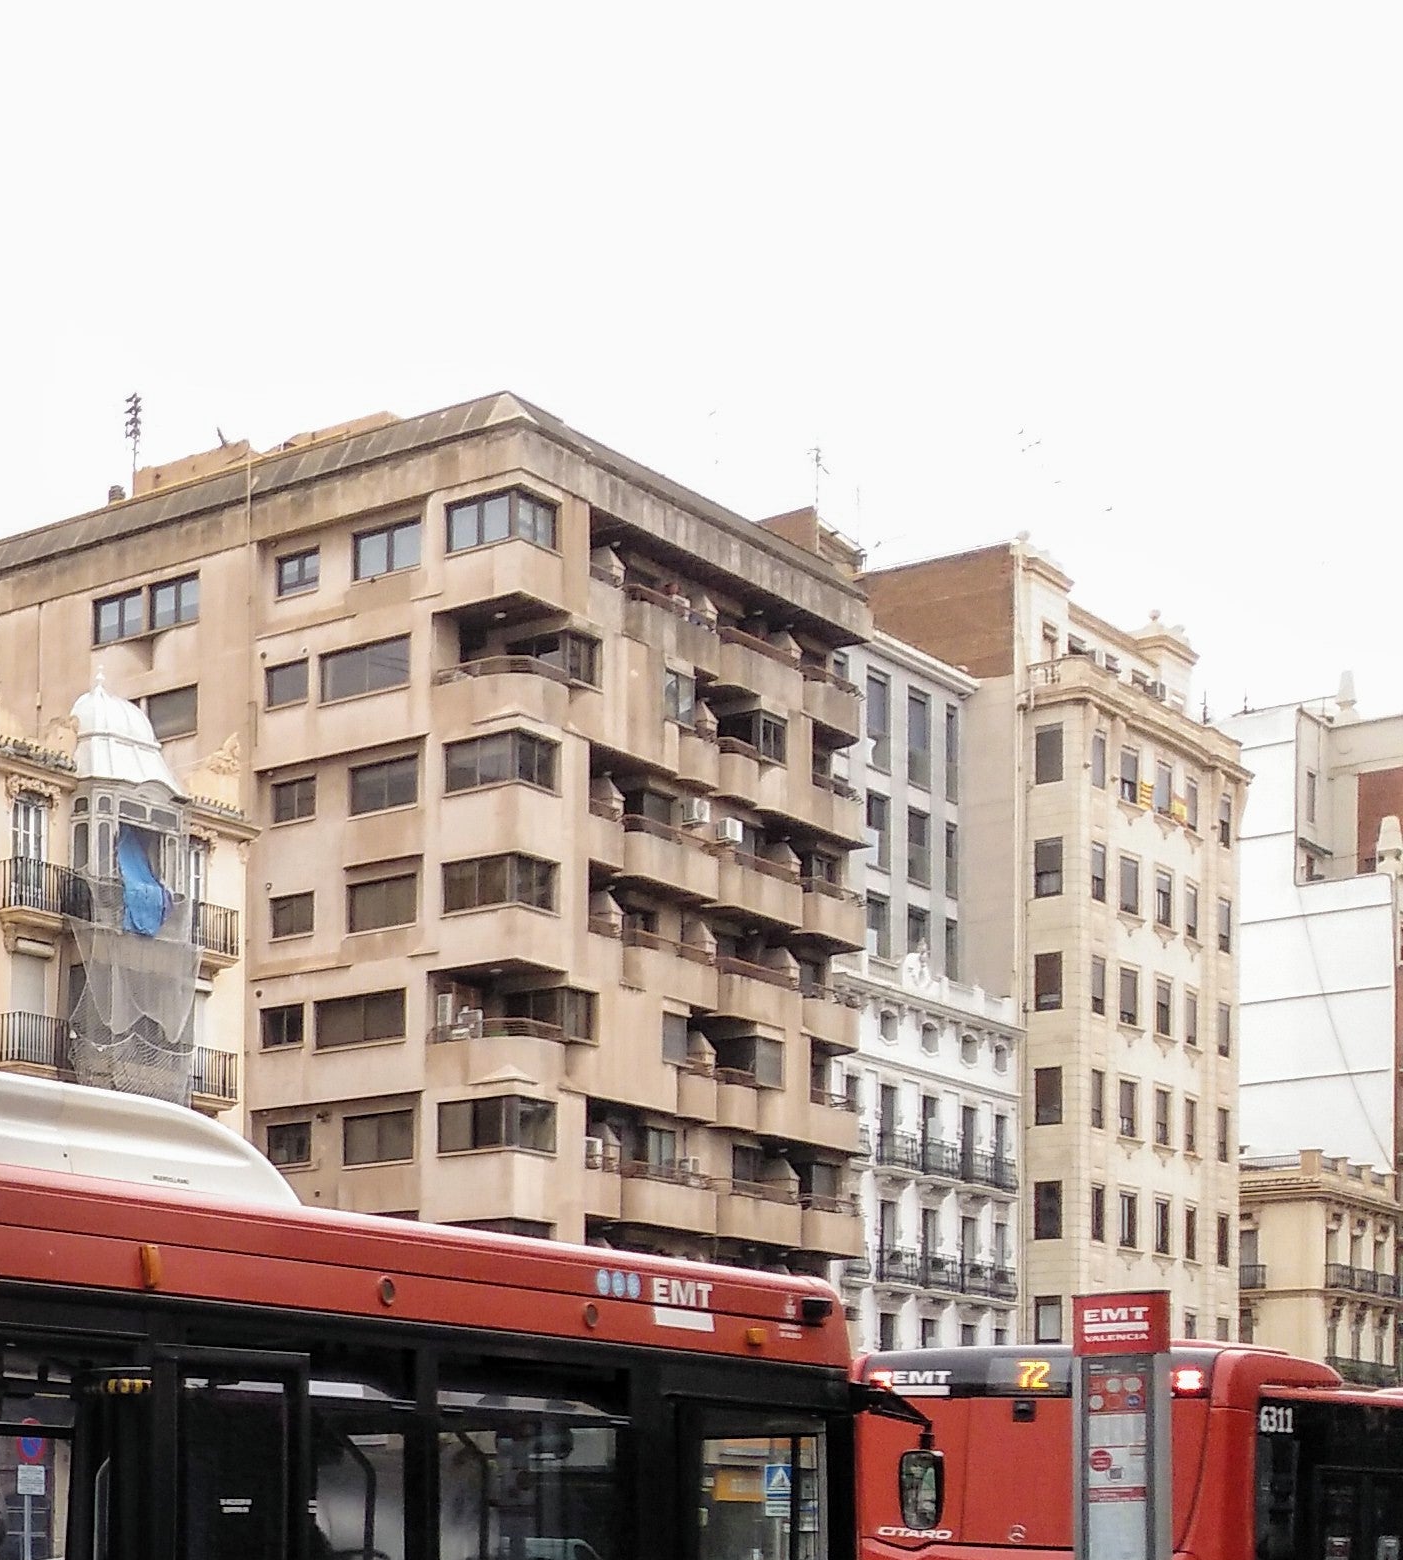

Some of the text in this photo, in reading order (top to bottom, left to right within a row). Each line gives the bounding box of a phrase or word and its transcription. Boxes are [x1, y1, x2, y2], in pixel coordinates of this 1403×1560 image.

[652, 1276, 714, 1309] EMT
[1083, 1306, 1150, 1323] EMT
[1083, 1333, 1149, 1343] VALENCIA
[892, 1370, 953, 1385] EMT
[1016, 1360, 1051, 1389] 72
[1259, 1405, 1294, 1434] 6311
[877, 1526, 953, 1540] CITARO
